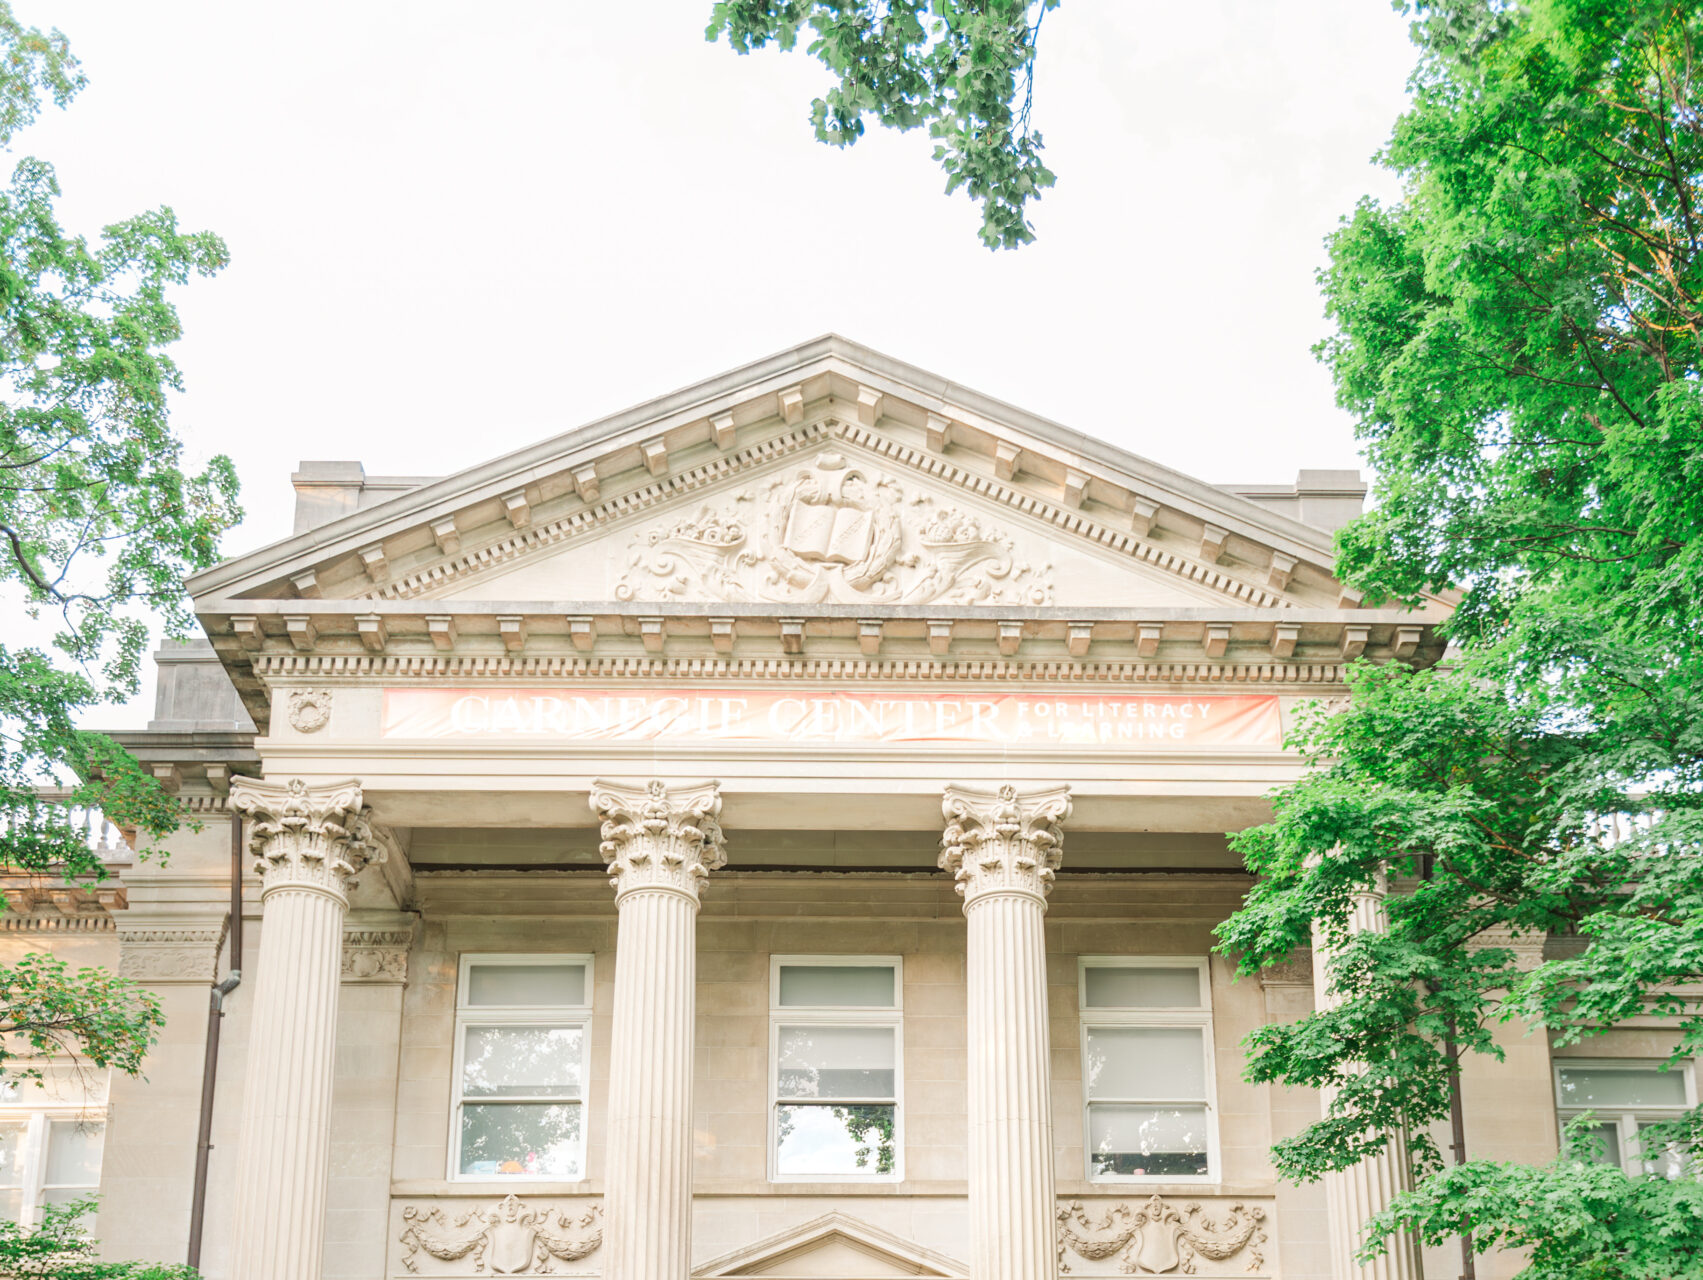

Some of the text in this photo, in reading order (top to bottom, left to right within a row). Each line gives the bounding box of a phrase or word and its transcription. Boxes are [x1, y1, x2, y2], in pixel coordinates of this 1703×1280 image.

[450, 696, 1009, 739] CARNEGIE CENTER
[1018, 702, 1212, 719] FOR LITERACY
[1018, 721, 1034, 738] &
